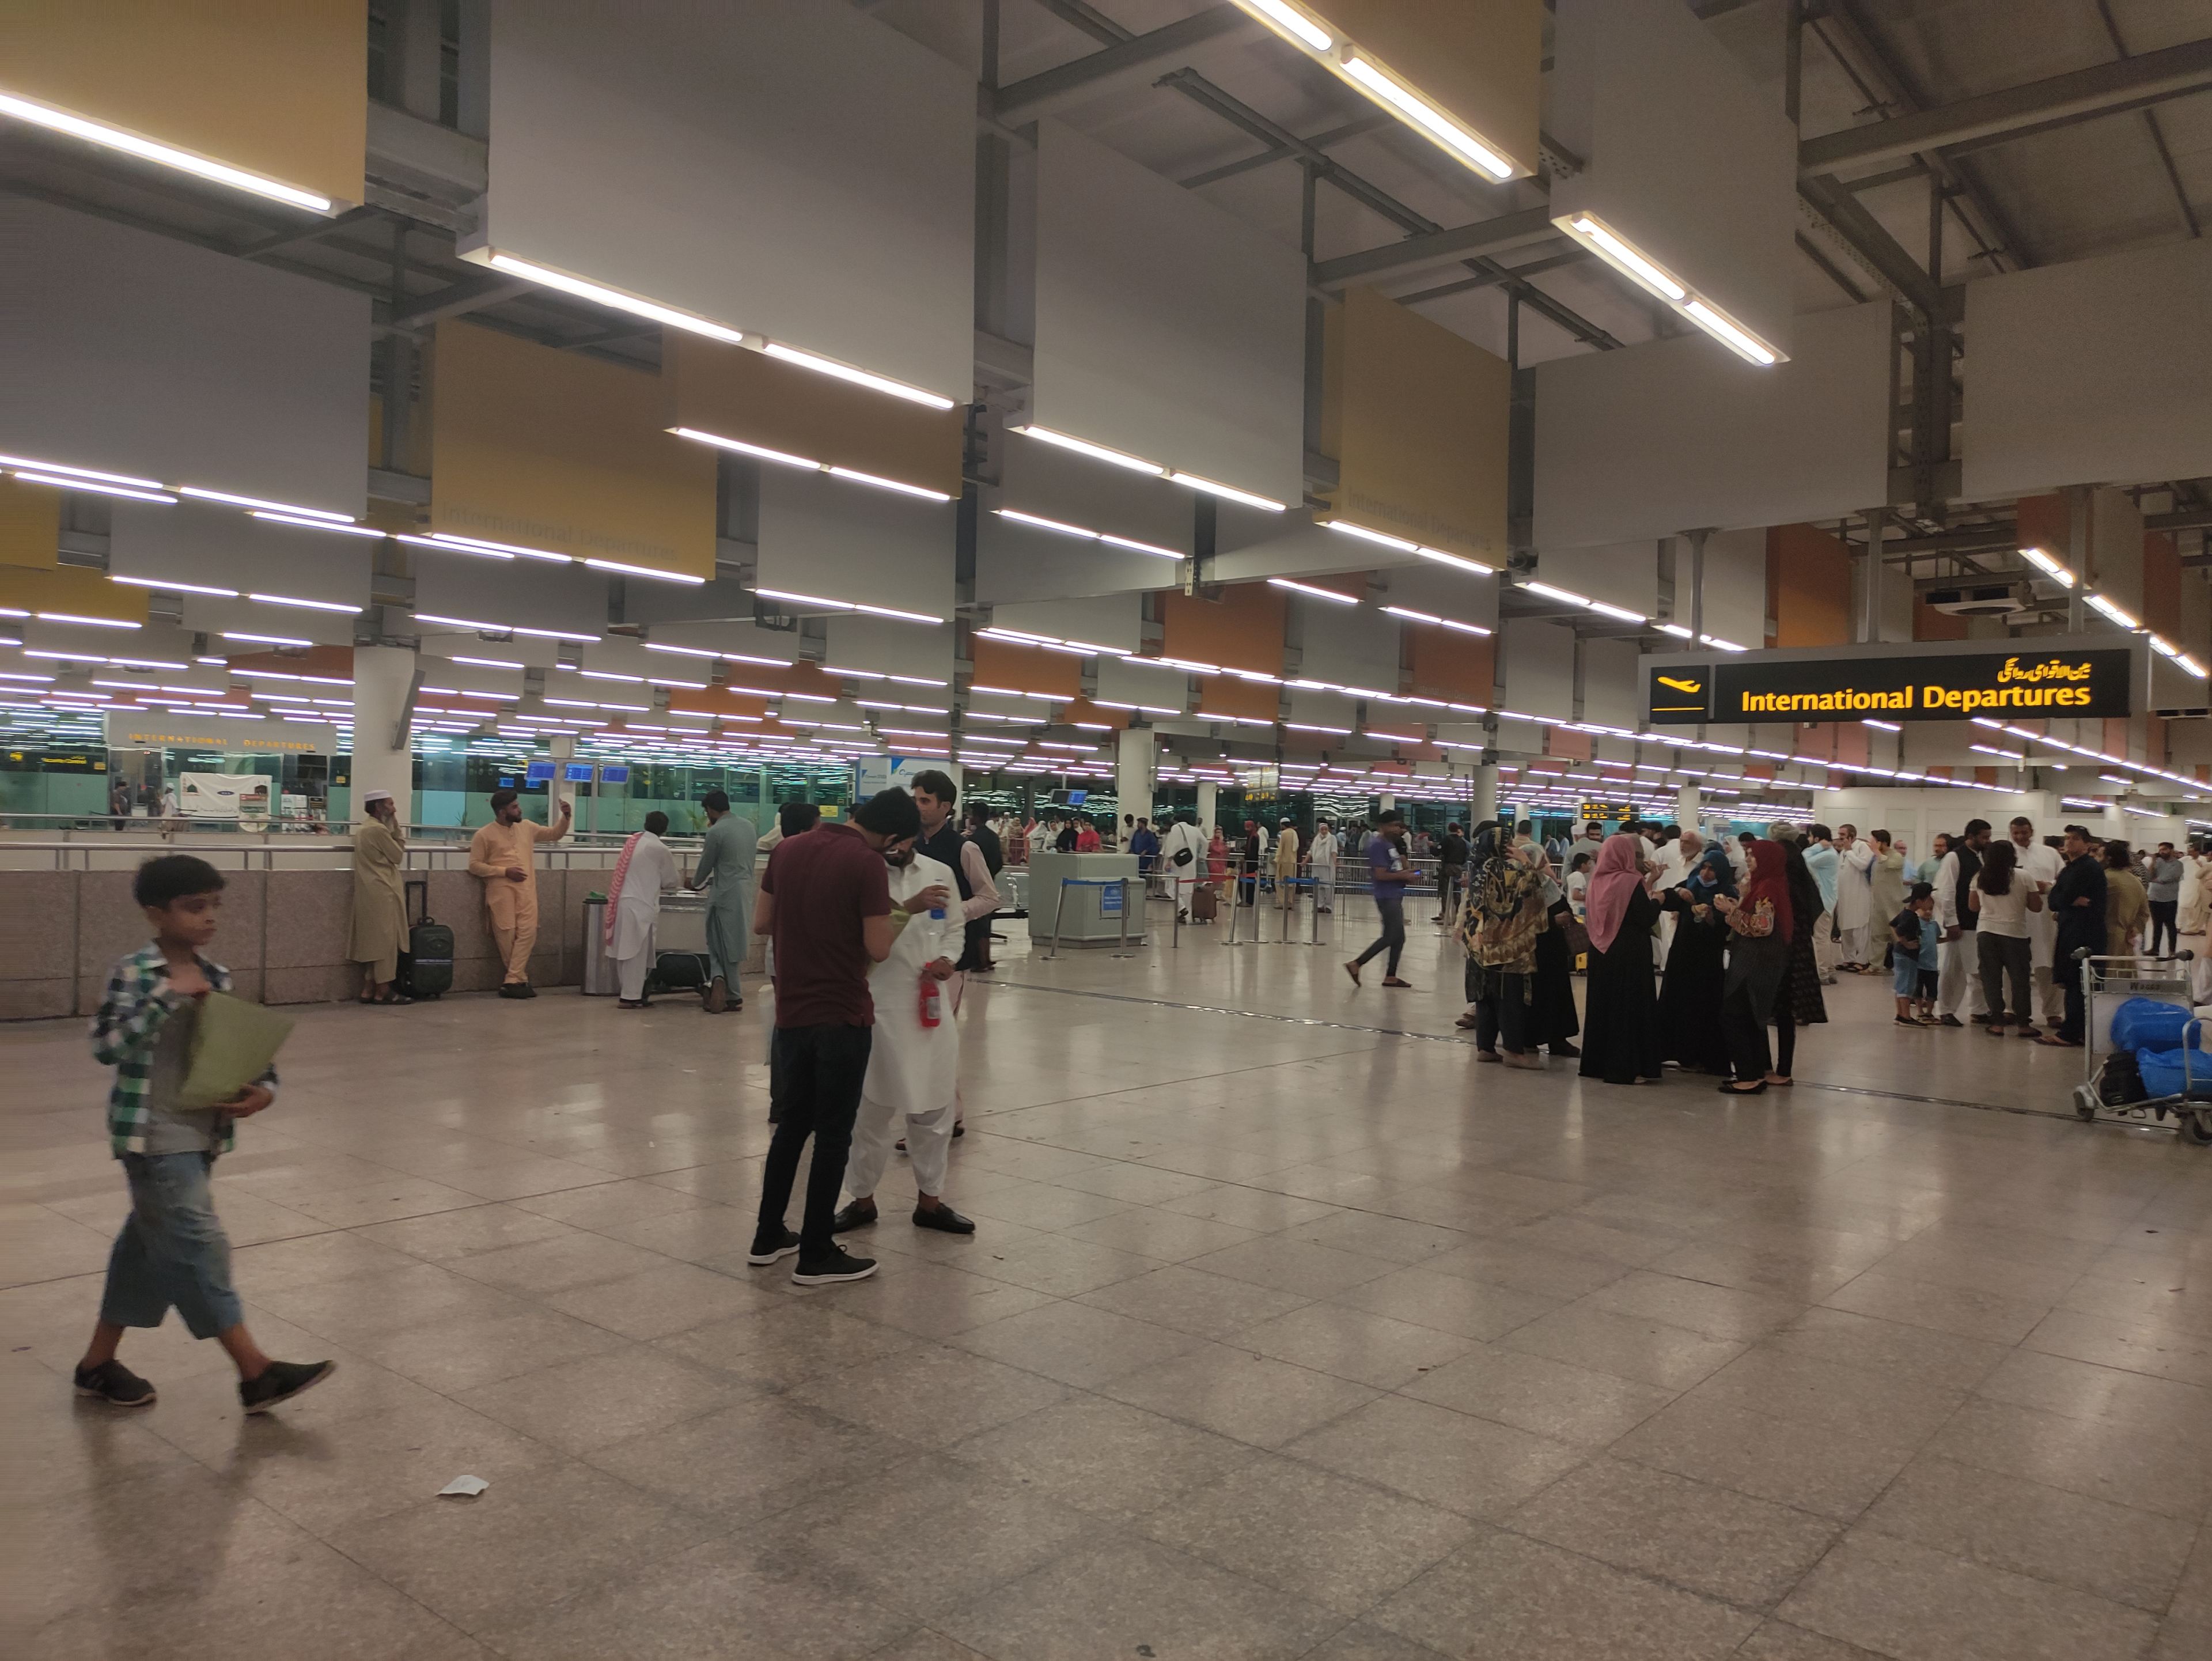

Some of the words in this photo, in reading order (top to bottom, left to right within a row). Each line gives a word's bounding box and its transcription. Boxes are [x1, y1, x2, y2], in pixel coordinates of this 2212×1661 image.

[1741, 685, 1913, 712] International
[1923, 685, 2092, 713] Departures
[128, 732, 229, 746] INTERNATIONAL
[243, 739, 316, 751] DEPARTURES
